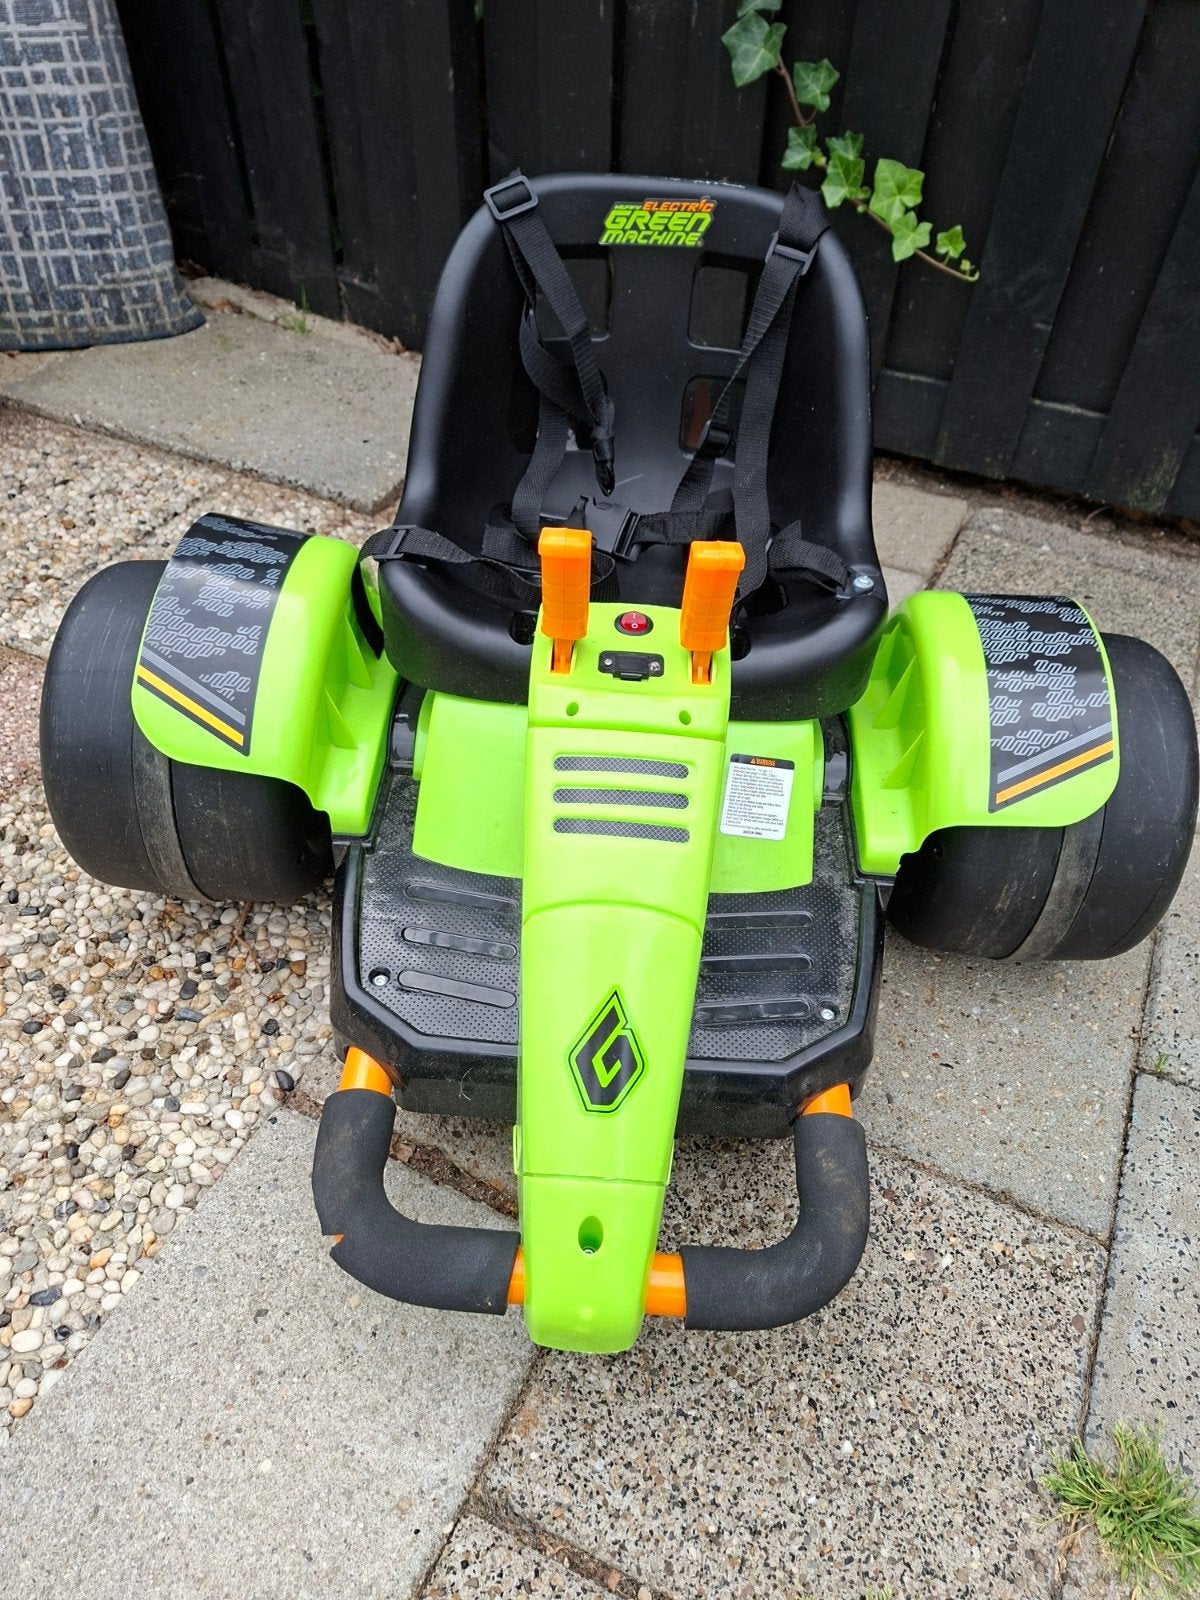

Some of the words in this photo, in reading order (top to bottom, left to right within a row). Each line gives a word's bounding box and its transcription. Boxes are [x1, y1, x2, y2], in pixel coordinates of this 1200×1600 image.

[642, 199, 714, 212] ELECTRIC
[605, 210, 711, 232] GREEN
[601, 230, 701, 246] MACHINE
